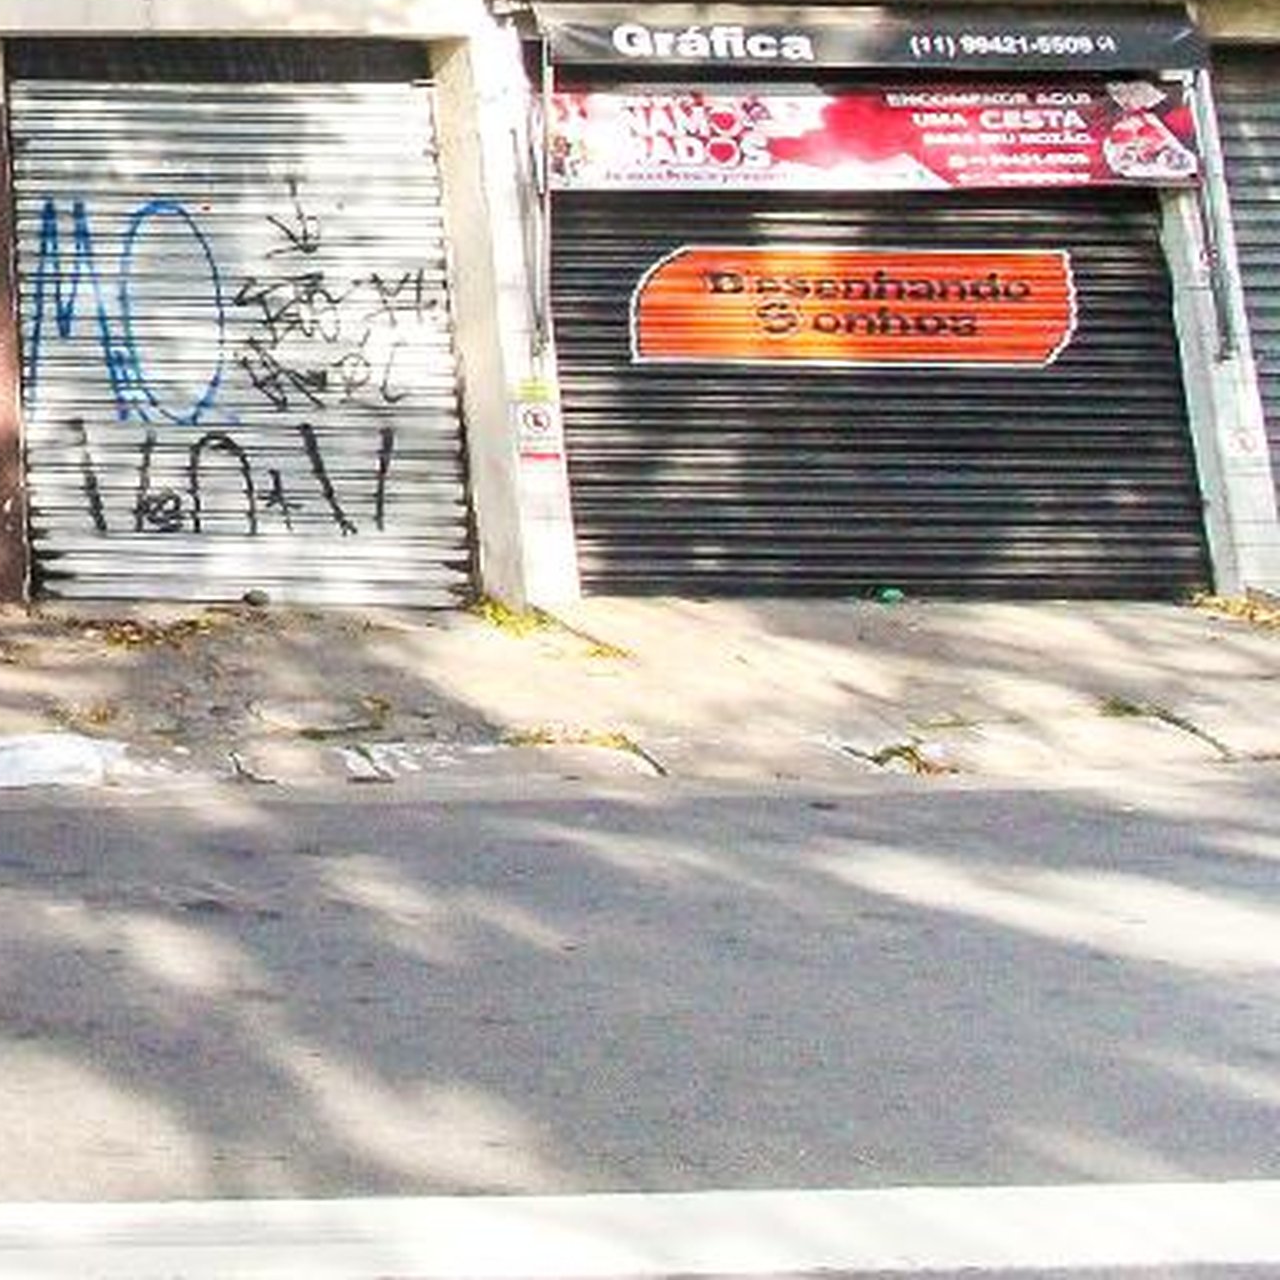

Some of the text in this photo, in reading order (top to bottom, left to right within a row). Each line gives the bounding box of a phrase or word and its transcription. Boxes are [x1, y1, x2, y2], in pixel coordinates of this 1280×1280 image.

[612, 24, 814, 61] Gráfica
[910, 34, 955, 58] (11)
[978, 110, 1087, 130] CESTA
[706, 270, 1032, 301] Desenhando
